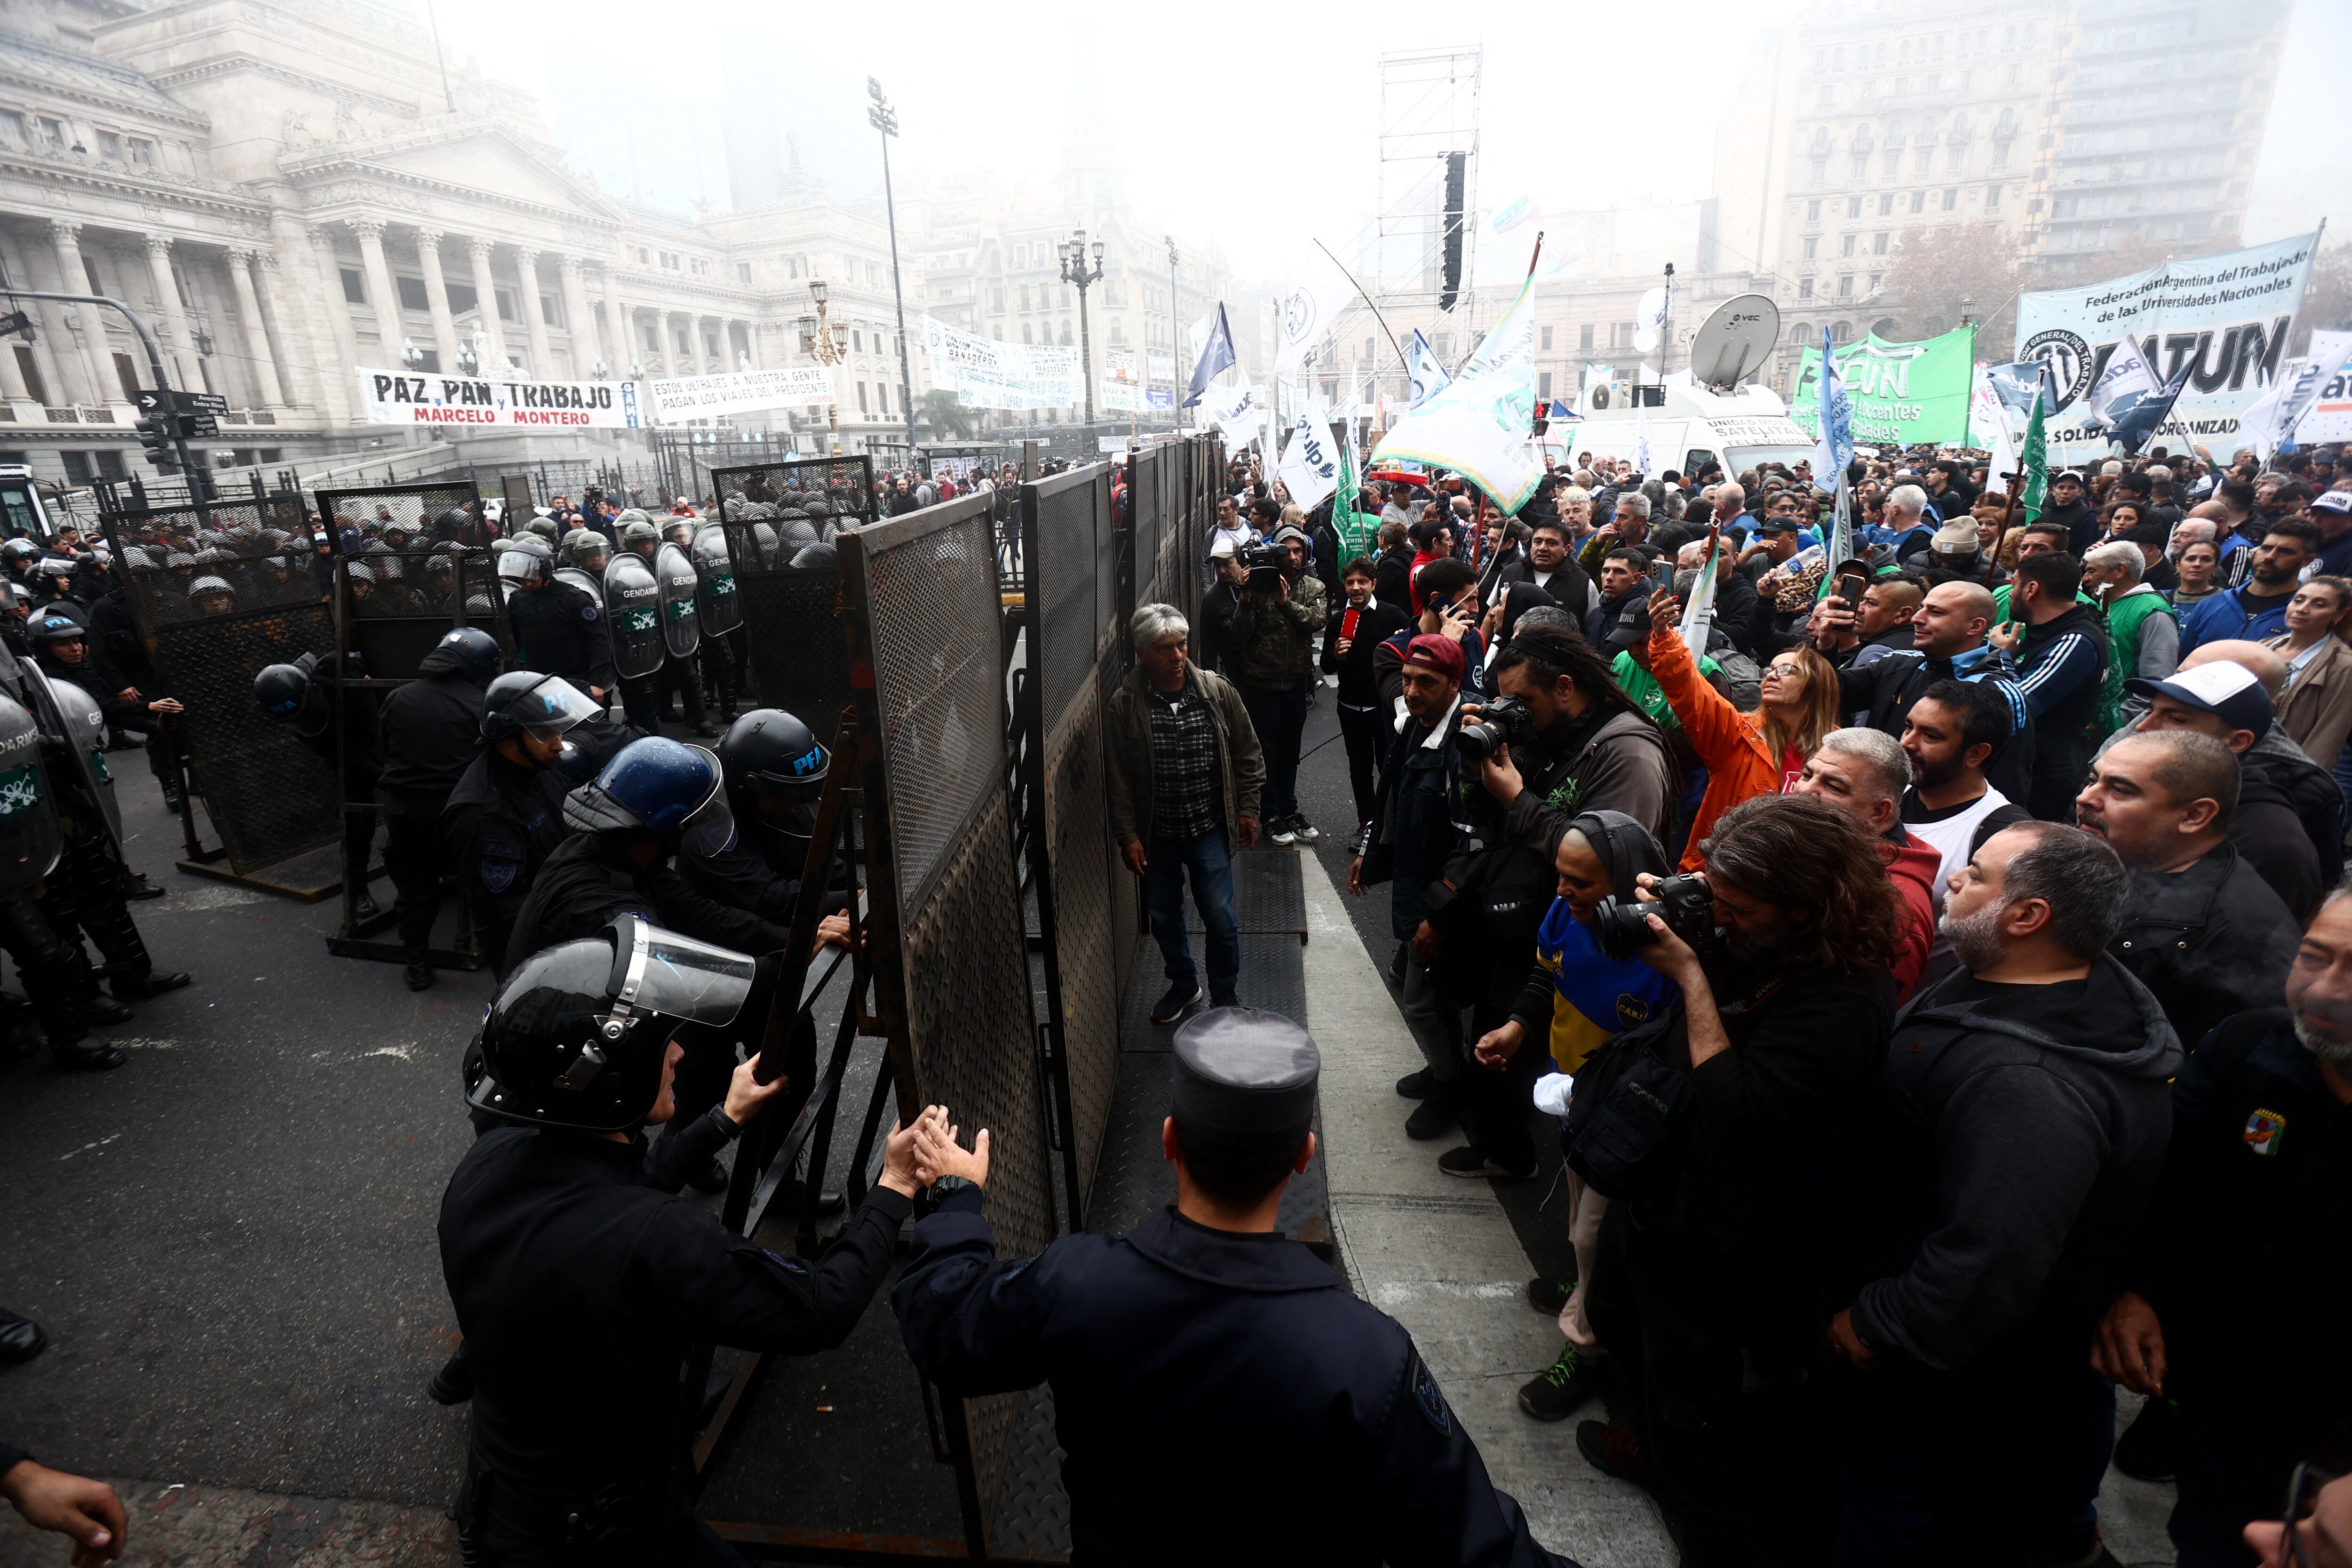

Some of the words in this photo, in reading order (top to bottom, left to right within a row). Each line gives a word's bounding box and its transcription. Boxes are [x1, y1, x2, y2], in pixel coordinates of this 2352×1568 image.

[2085, 278, 2162, 308] Federación
[2162, 274, 2214, 290] Argentina
[2217, 267, 2238, 282] del
[2097, 310, 2114, 323] de
[2118, 305, 2137, 318] las
[2218, 277, 2292, 303] Nacionales
[2030, 331, 2070, 346] GENERAL
[2071, 337, 2084, 352] DEL
[655, 382, 683, 395] ESTOS
[685, 377, 727, 391] ULTRAJES
[733, 377, 739, 387] A
[744, 373, 787, 385] NUESTRA
[792, 370, 821, 382] GENTE
[2072, 351, 2091, 397] TRABAJO
[441, 380, 493, 405] PAN
[502, 383, 612, 409] TRABAJO
[700, 393, 717, 405] LOS
[720, 389, 753, 402] VIAJES
[756, 387, 773, 397] DEL
[414, 408, 495, 423] MARCELO
[514, 411, 589, 425] MONTERO
[1716, 427, 1804, 437] SATELITAL
[2157, 418, 2241, 436] ORGANIZAD
[1724, 438, 1811, 446] TELEVISION
[794, 746, 822, 776] PFA
[1619, 1004, 1644, 1021] CABJ
